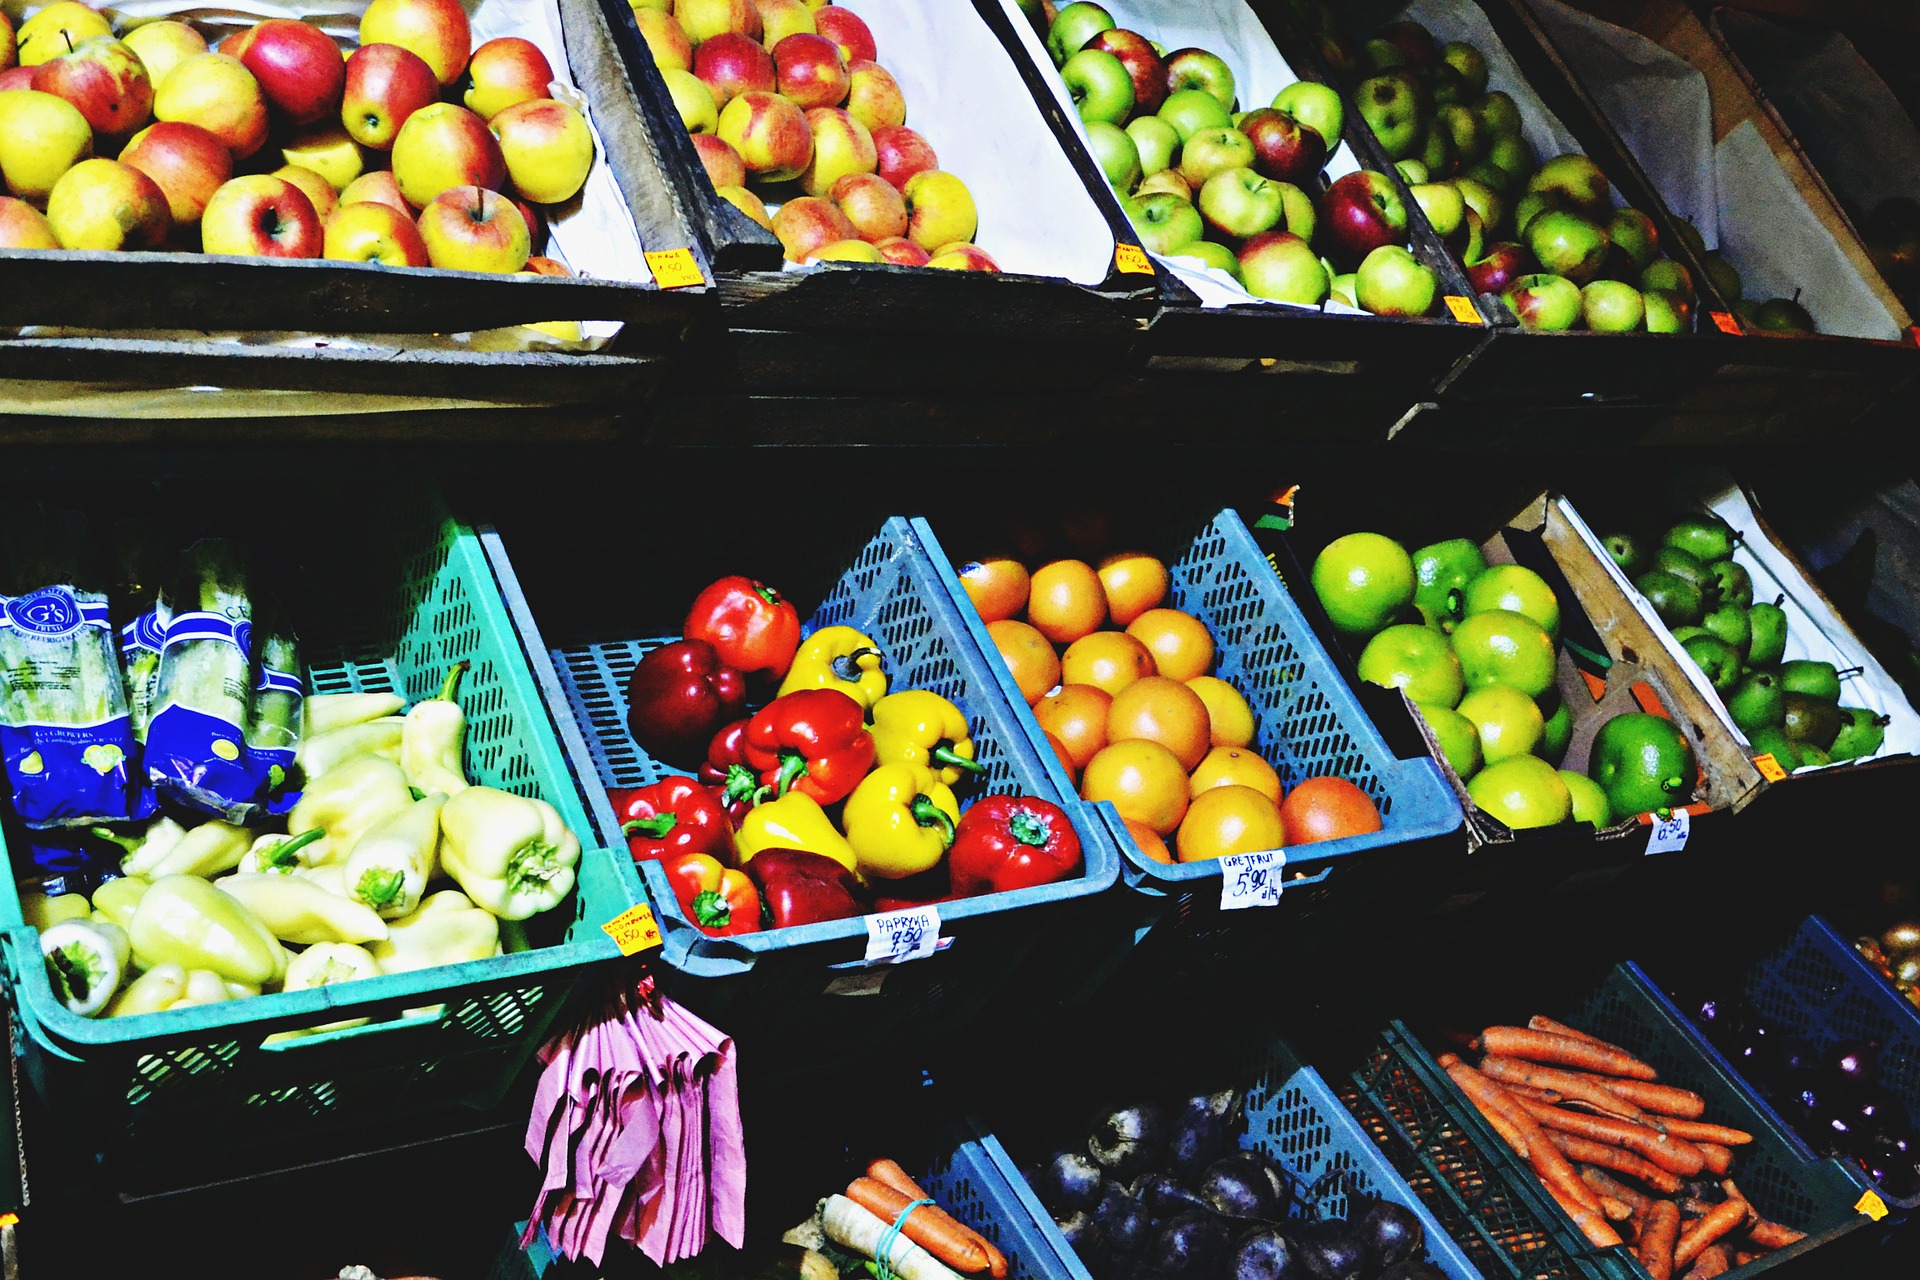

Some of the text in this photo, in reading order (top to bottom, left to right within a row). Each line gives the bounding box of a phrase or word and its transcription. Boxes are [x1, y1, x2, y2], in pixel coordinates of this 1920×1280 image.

[26, 603, 65, 623] G's
[1223, 853, 1274, 872] GREJFRUT
[876, 914, 930, 934] PAPRYKA
